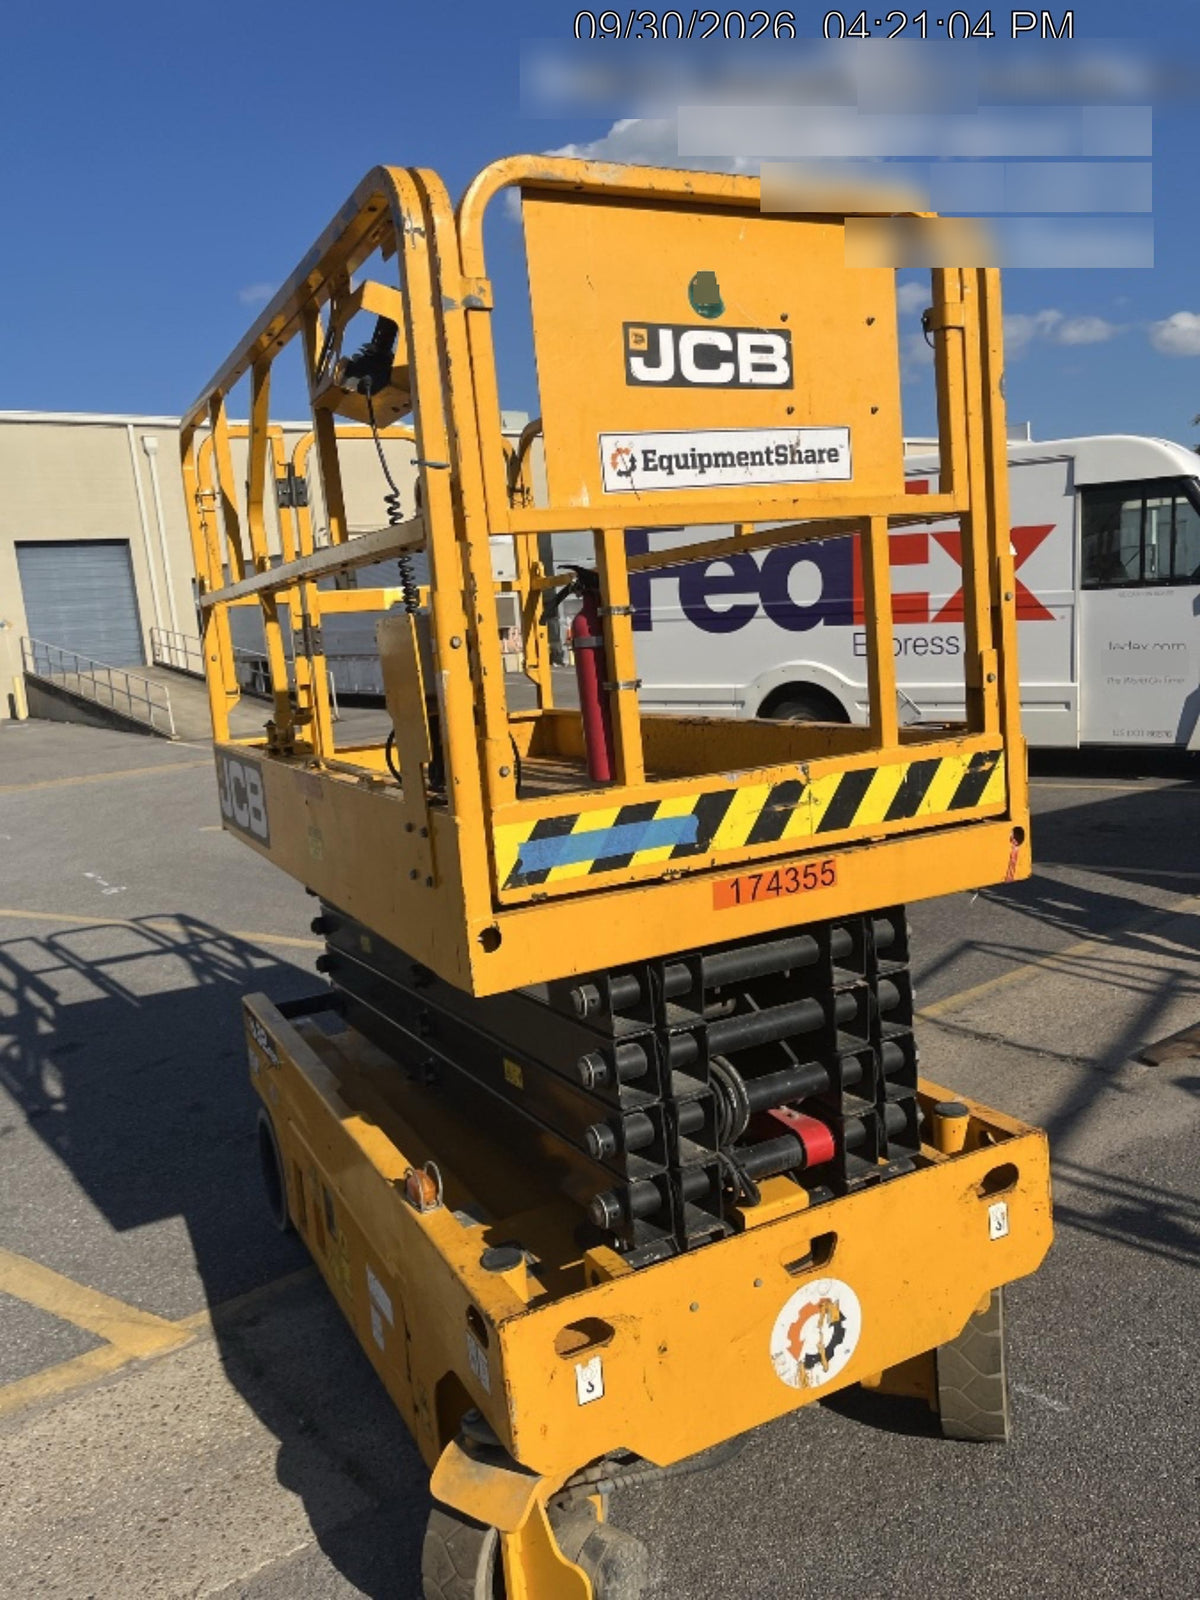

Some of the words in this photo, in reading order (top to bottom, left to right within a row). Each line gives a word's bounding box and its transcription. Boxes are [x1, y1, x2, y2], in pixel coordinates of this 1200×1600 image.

[629, 328, 790, 384] JCB
[641, 444, 840, 475] EquipmentShare
[853, 632, 960, 657] Eress
[222, 757, 269, 838] JCB
[730, 860, 835, 904] 174355
